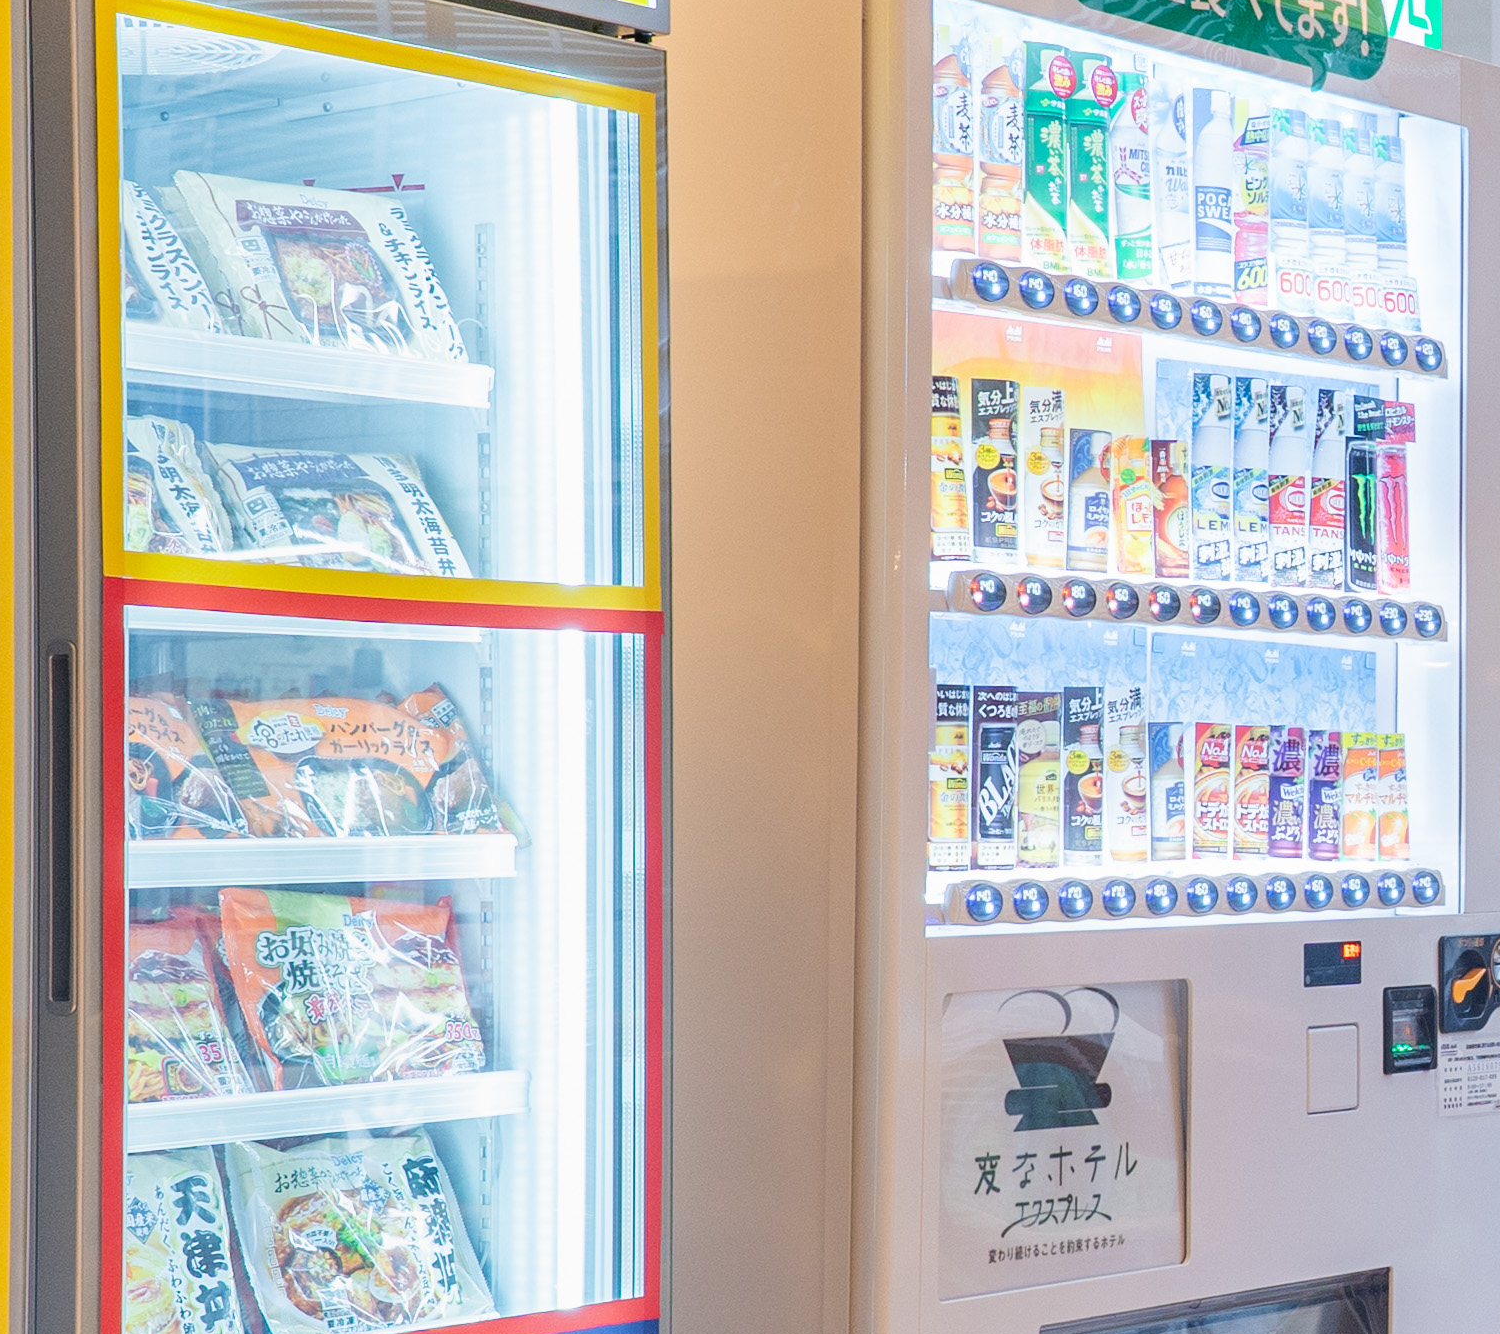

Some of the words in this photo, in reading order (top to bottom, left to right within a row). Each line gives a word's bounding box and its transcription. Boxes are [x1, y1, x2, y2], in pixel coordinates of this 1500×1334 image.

[1030, 237, 1064, 254] 体脂肪
[1074, 245, 1107, 260] 体脂肪
[1384, 292, 1416, 315] 600
[974, 1141, 1138, 1196] 変なホテル
[170, 1174, 233, 1333] 天津丼
[987, 1233, 1126, 1265] 変わり続けることを約束するホテル
